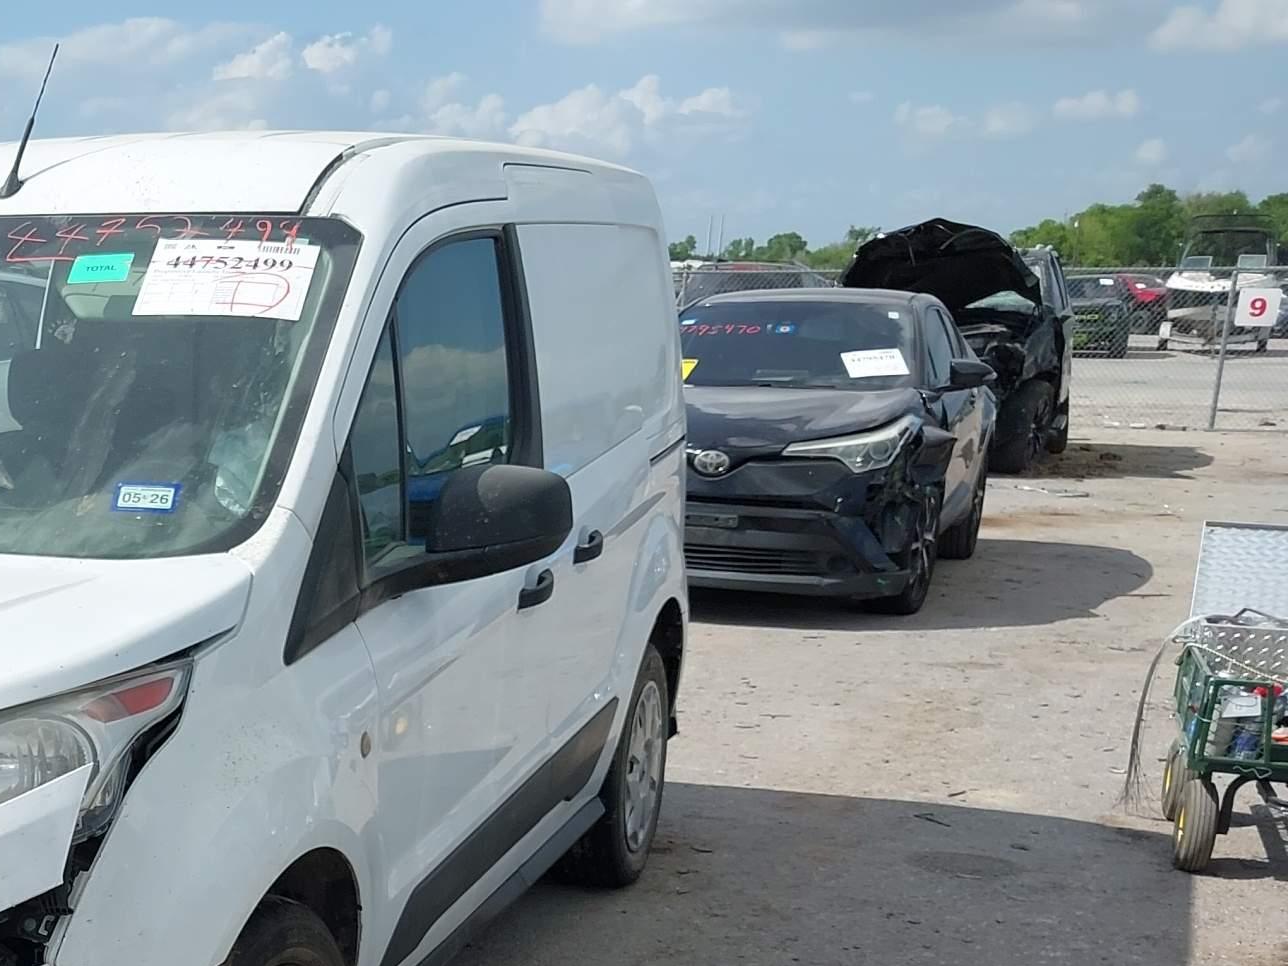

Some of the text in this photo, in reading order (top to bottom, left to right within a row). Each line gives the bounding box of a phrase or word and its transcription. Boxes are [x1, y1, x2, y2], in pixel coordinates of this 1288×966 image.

[85, 264, 117, 272] TOTAL
[166, 254, 294, 272] 44752499
[1249, 298, 1268, 317] 9
[122, 492, 169, 504] 05 26
